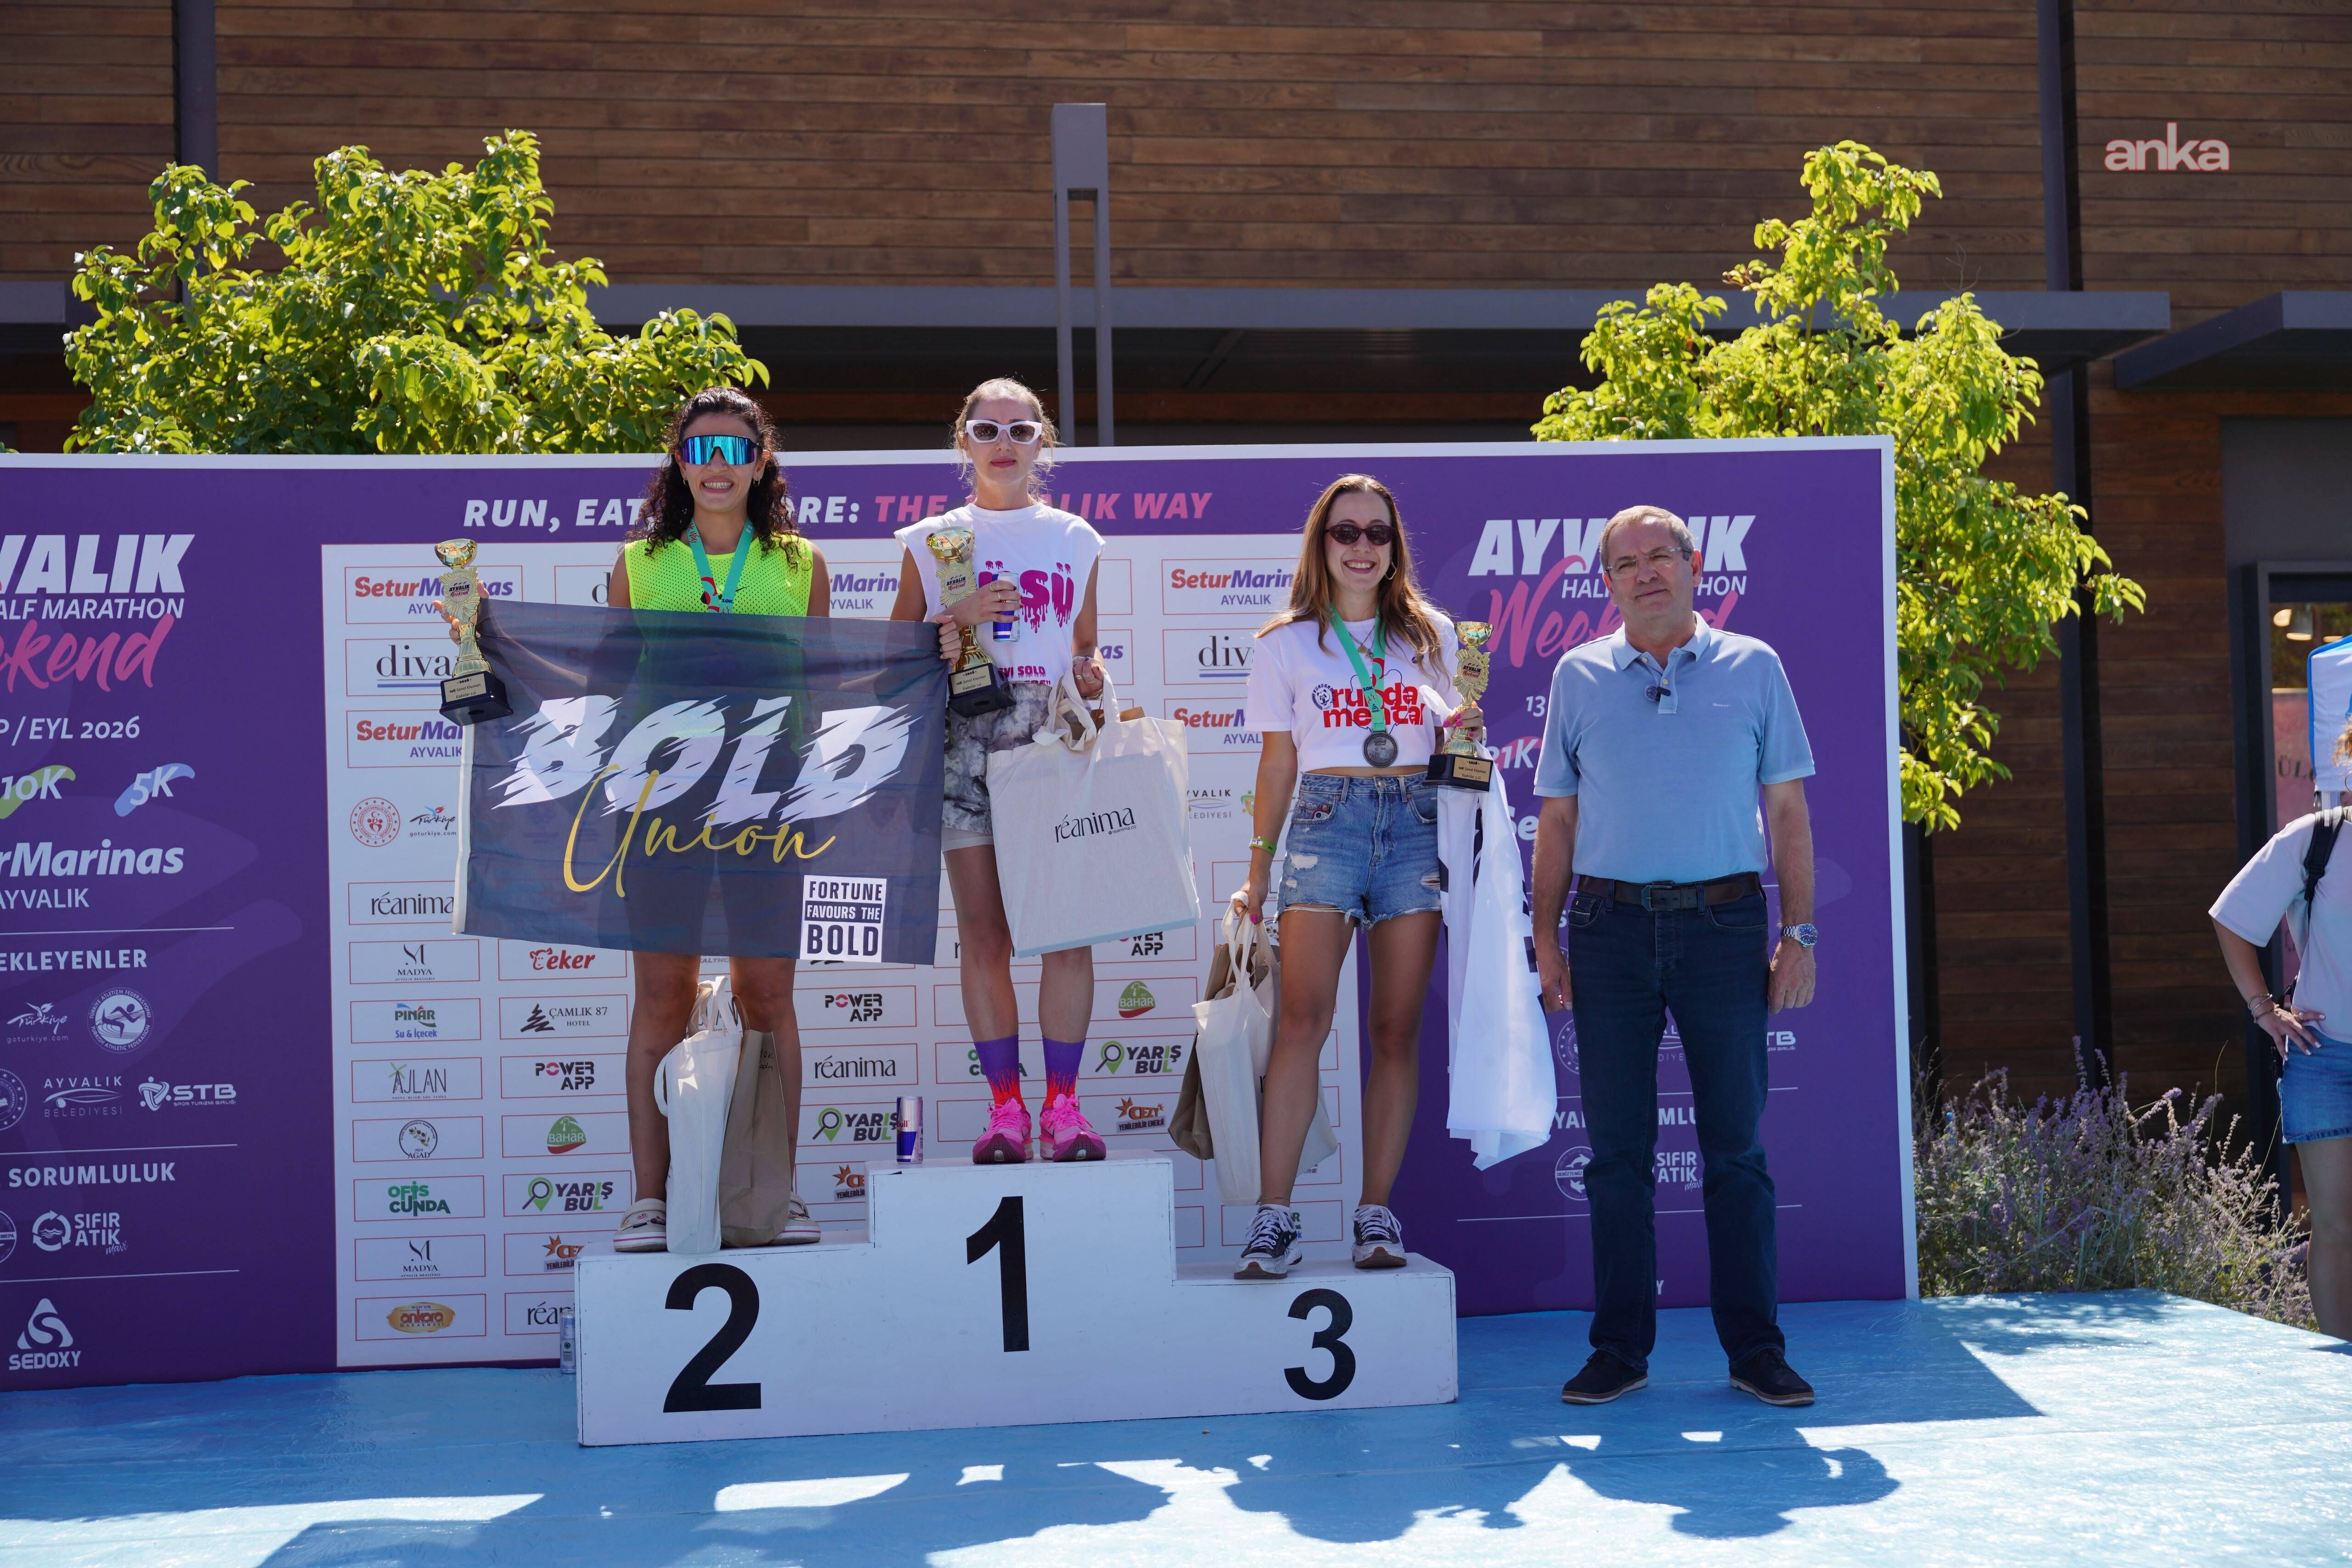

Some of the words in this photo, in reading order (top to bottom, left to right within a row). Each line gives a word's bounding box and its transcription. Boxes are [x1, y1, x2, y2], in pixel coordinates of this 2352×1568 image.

[463, 499, 560, 533] RUN,
[875, 495, 948, 522] THE
[1134, 492, 1213, 519] WAY
[947, 576, 966, 586] AYVALIK
[1221, 594, 1271, 605] AYVALIK
[42, 598, 184, 619] MARATHON
[1018, 665, 1046, 678] SOLO
[29, 717, 74, 739] EYL
[81, 716, 140, 739] 2026
[488, 695, 923, 829] BOLD
[1, 768, 67, 800] 10K
[130, 767, 179, 806] 5K
[563, 764, 836, 898] Union
[1055, 807, 1136, 843] réanima
[809, 881, 882, 901] FORTUNE
[807, 905, 856, 919] FAVOURS
[861, 907, 881, 920] THE
[807, 924, 878, 956] BOLD
[1131, 942, 1163, 956] APP
[825, 993, 882, 1008] POWER
[395, 1010, 435, 1021] PINAR
[549, 1007, 593, 1019] ÇAMLIK
[595, 1006, 608, 1015] 87
[850, 1008, 882, 1022] APP
[7, 1034, 69, 1044] goturkiye.com
[395, 1030, 405, 1038] Su
[414, 1028, 437, 1038] İçecek
[1126, 1045, 1182, 1063] YARIŞ
[535, 1061, 594, 1076] POWER
[814, 1055, 896, 1079] réanima
[1135, 1060, 1173, 1074] BUL
[44, 1076, 122, 1089] AYVALIK
[392, 1068, 447, 1094] AJLAN
[560, 1077, 595, 1090] APP
[173, 1083, 236, 1100] STB
[45, 1105, 122, 1117] BELEDİYESİ
[1128, 1106, 1159, 1120] CEZY
[853, 1128, 892, 1141] BUL
[1656, 1151, 1696, 1167] SIFIR
[9, 1162, 175, 1187] SORUMLULUK
[1657, 1167, 1697, 1183] ATIK
[555, 1182, 613, 1199] YARIŞ
[390, 1196, 451, 1217] CUNDA
[564, 1196, 603, 1211] BUL
[74, 1212, 120, 1229] SIFIR
[75, 1229, 120, 1246] ATIK
[967, 1196, 1029, 1353] 1
[400, 1309, 443, 1323] ankara
[663, 1263, 762, 1413] 2
[1283, 1288, 1357, 1401] 3
[9, 1351, 81, 1370] SEDOXY
